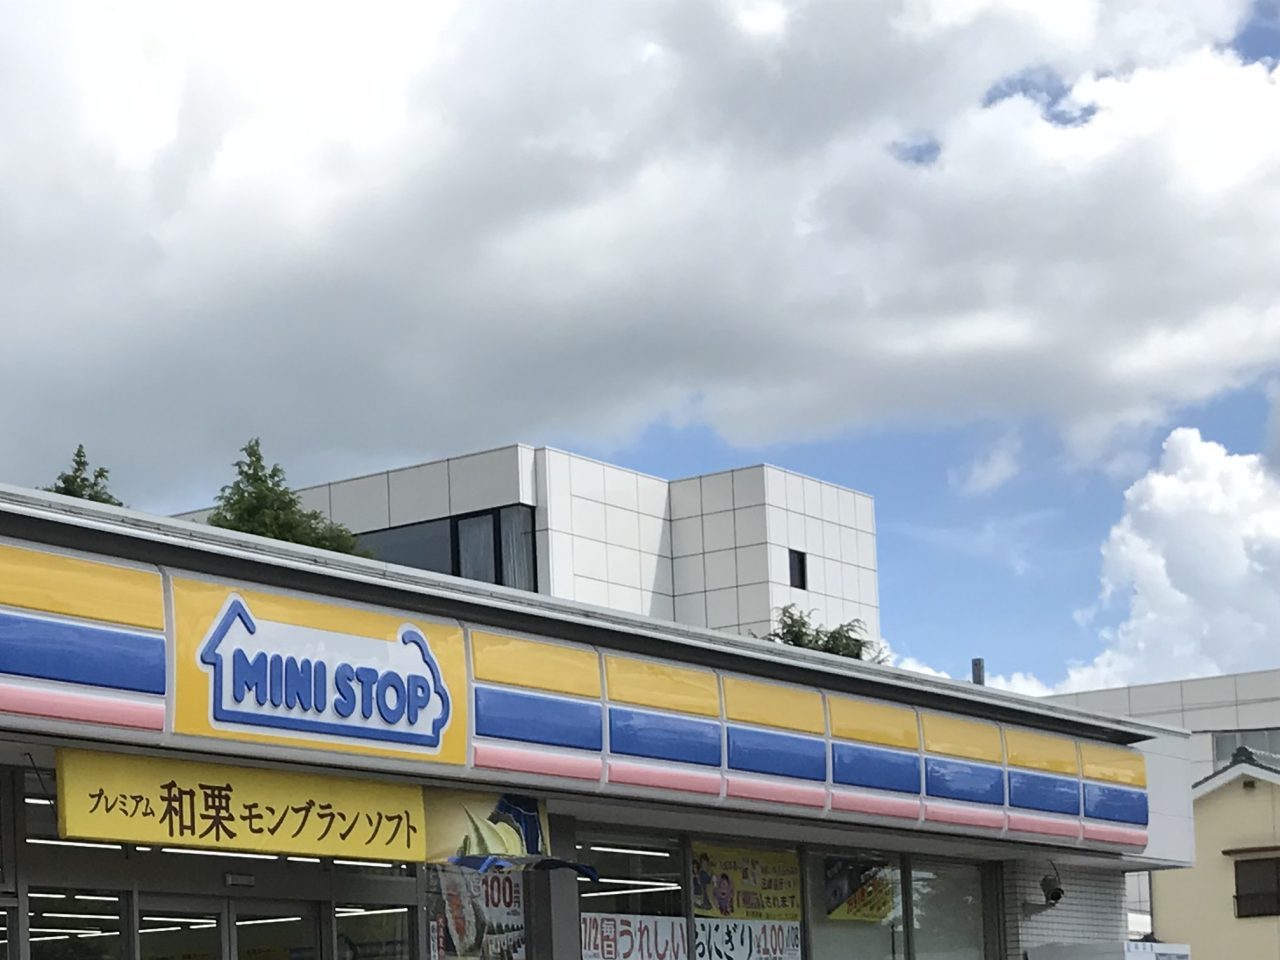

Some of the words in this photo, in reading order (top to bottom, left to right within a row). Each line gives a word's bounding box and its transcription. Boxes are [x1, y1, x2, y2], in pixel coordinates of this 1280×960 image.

[231, 647, 327, 713] MINI
[333, 662, 432, 725] STOP
[619, 918, 687, 960] うれしい
